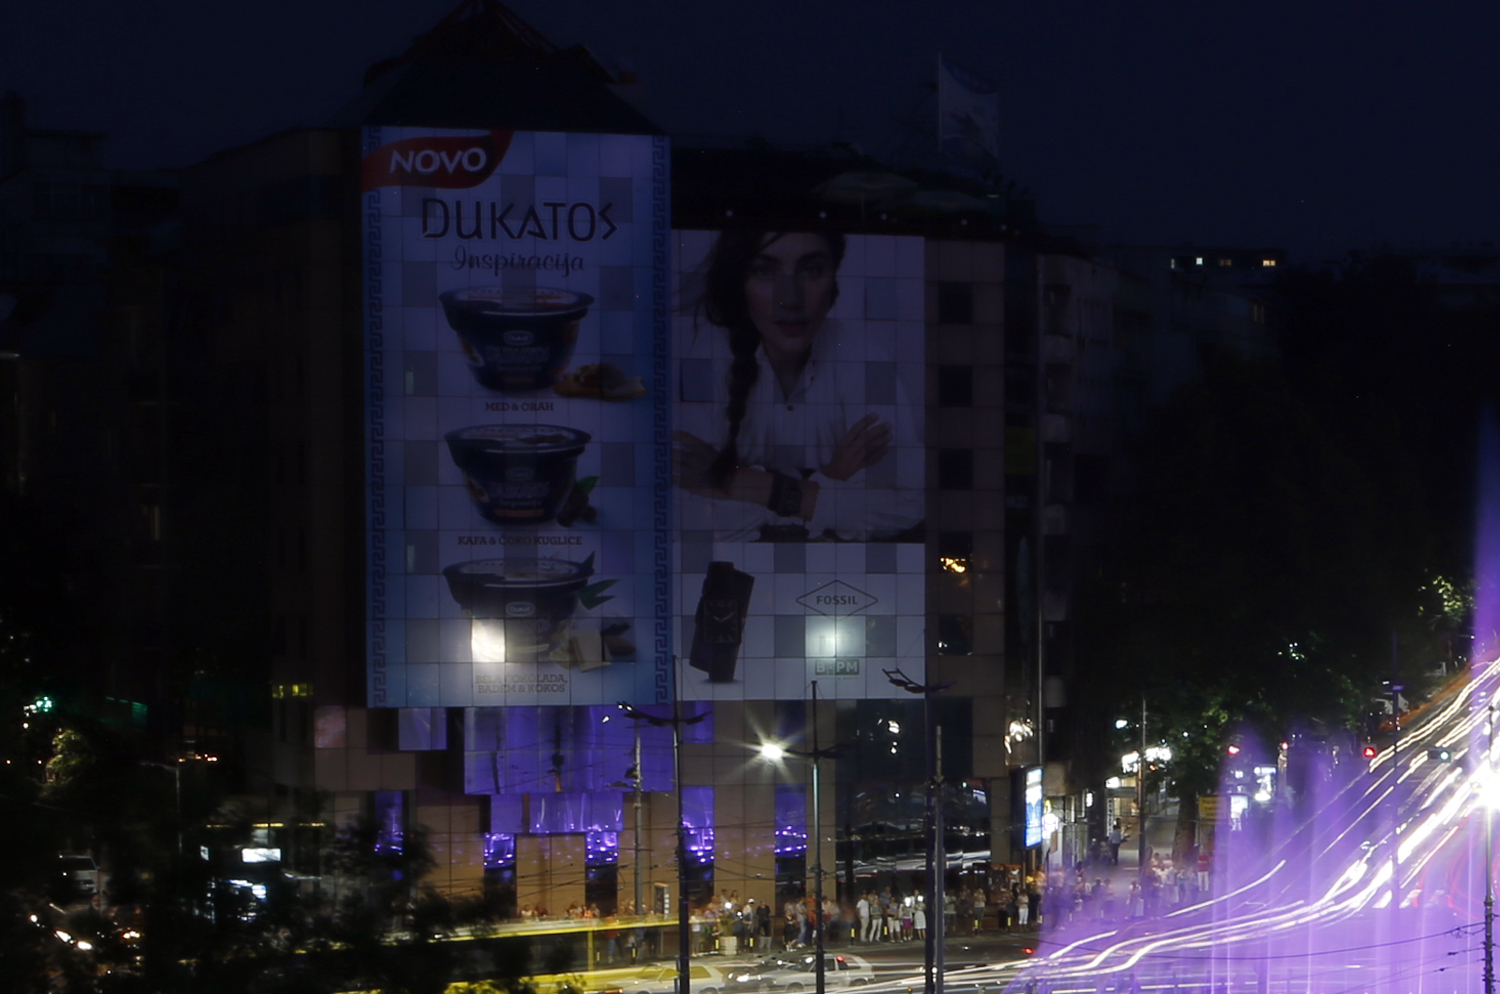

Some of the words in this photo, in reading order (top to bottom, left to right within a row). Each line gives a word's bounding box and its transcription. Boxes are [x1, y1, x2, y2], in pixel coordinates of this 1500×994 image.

[388, 146, 488, 174] NOVO
[421, 197, 618, 242] DUKATOS
[452, 245, 584, 277] Inspiracija
[485, 402, 509, 411] MED
[511, 403, 520, 411] &
[521, 402, 554, 411] ORAH
[457, 536, 487, 545] KAFA
[488, 536, 497, 545] &
[533, 536, 583, 545] KUGLICE
[816, 595, 858, 606] FOSSIL
[477, 684, 516, 694] BADEM
[517, 684, 526, 694] &
[527, 683, 566, 693] KOKOS
